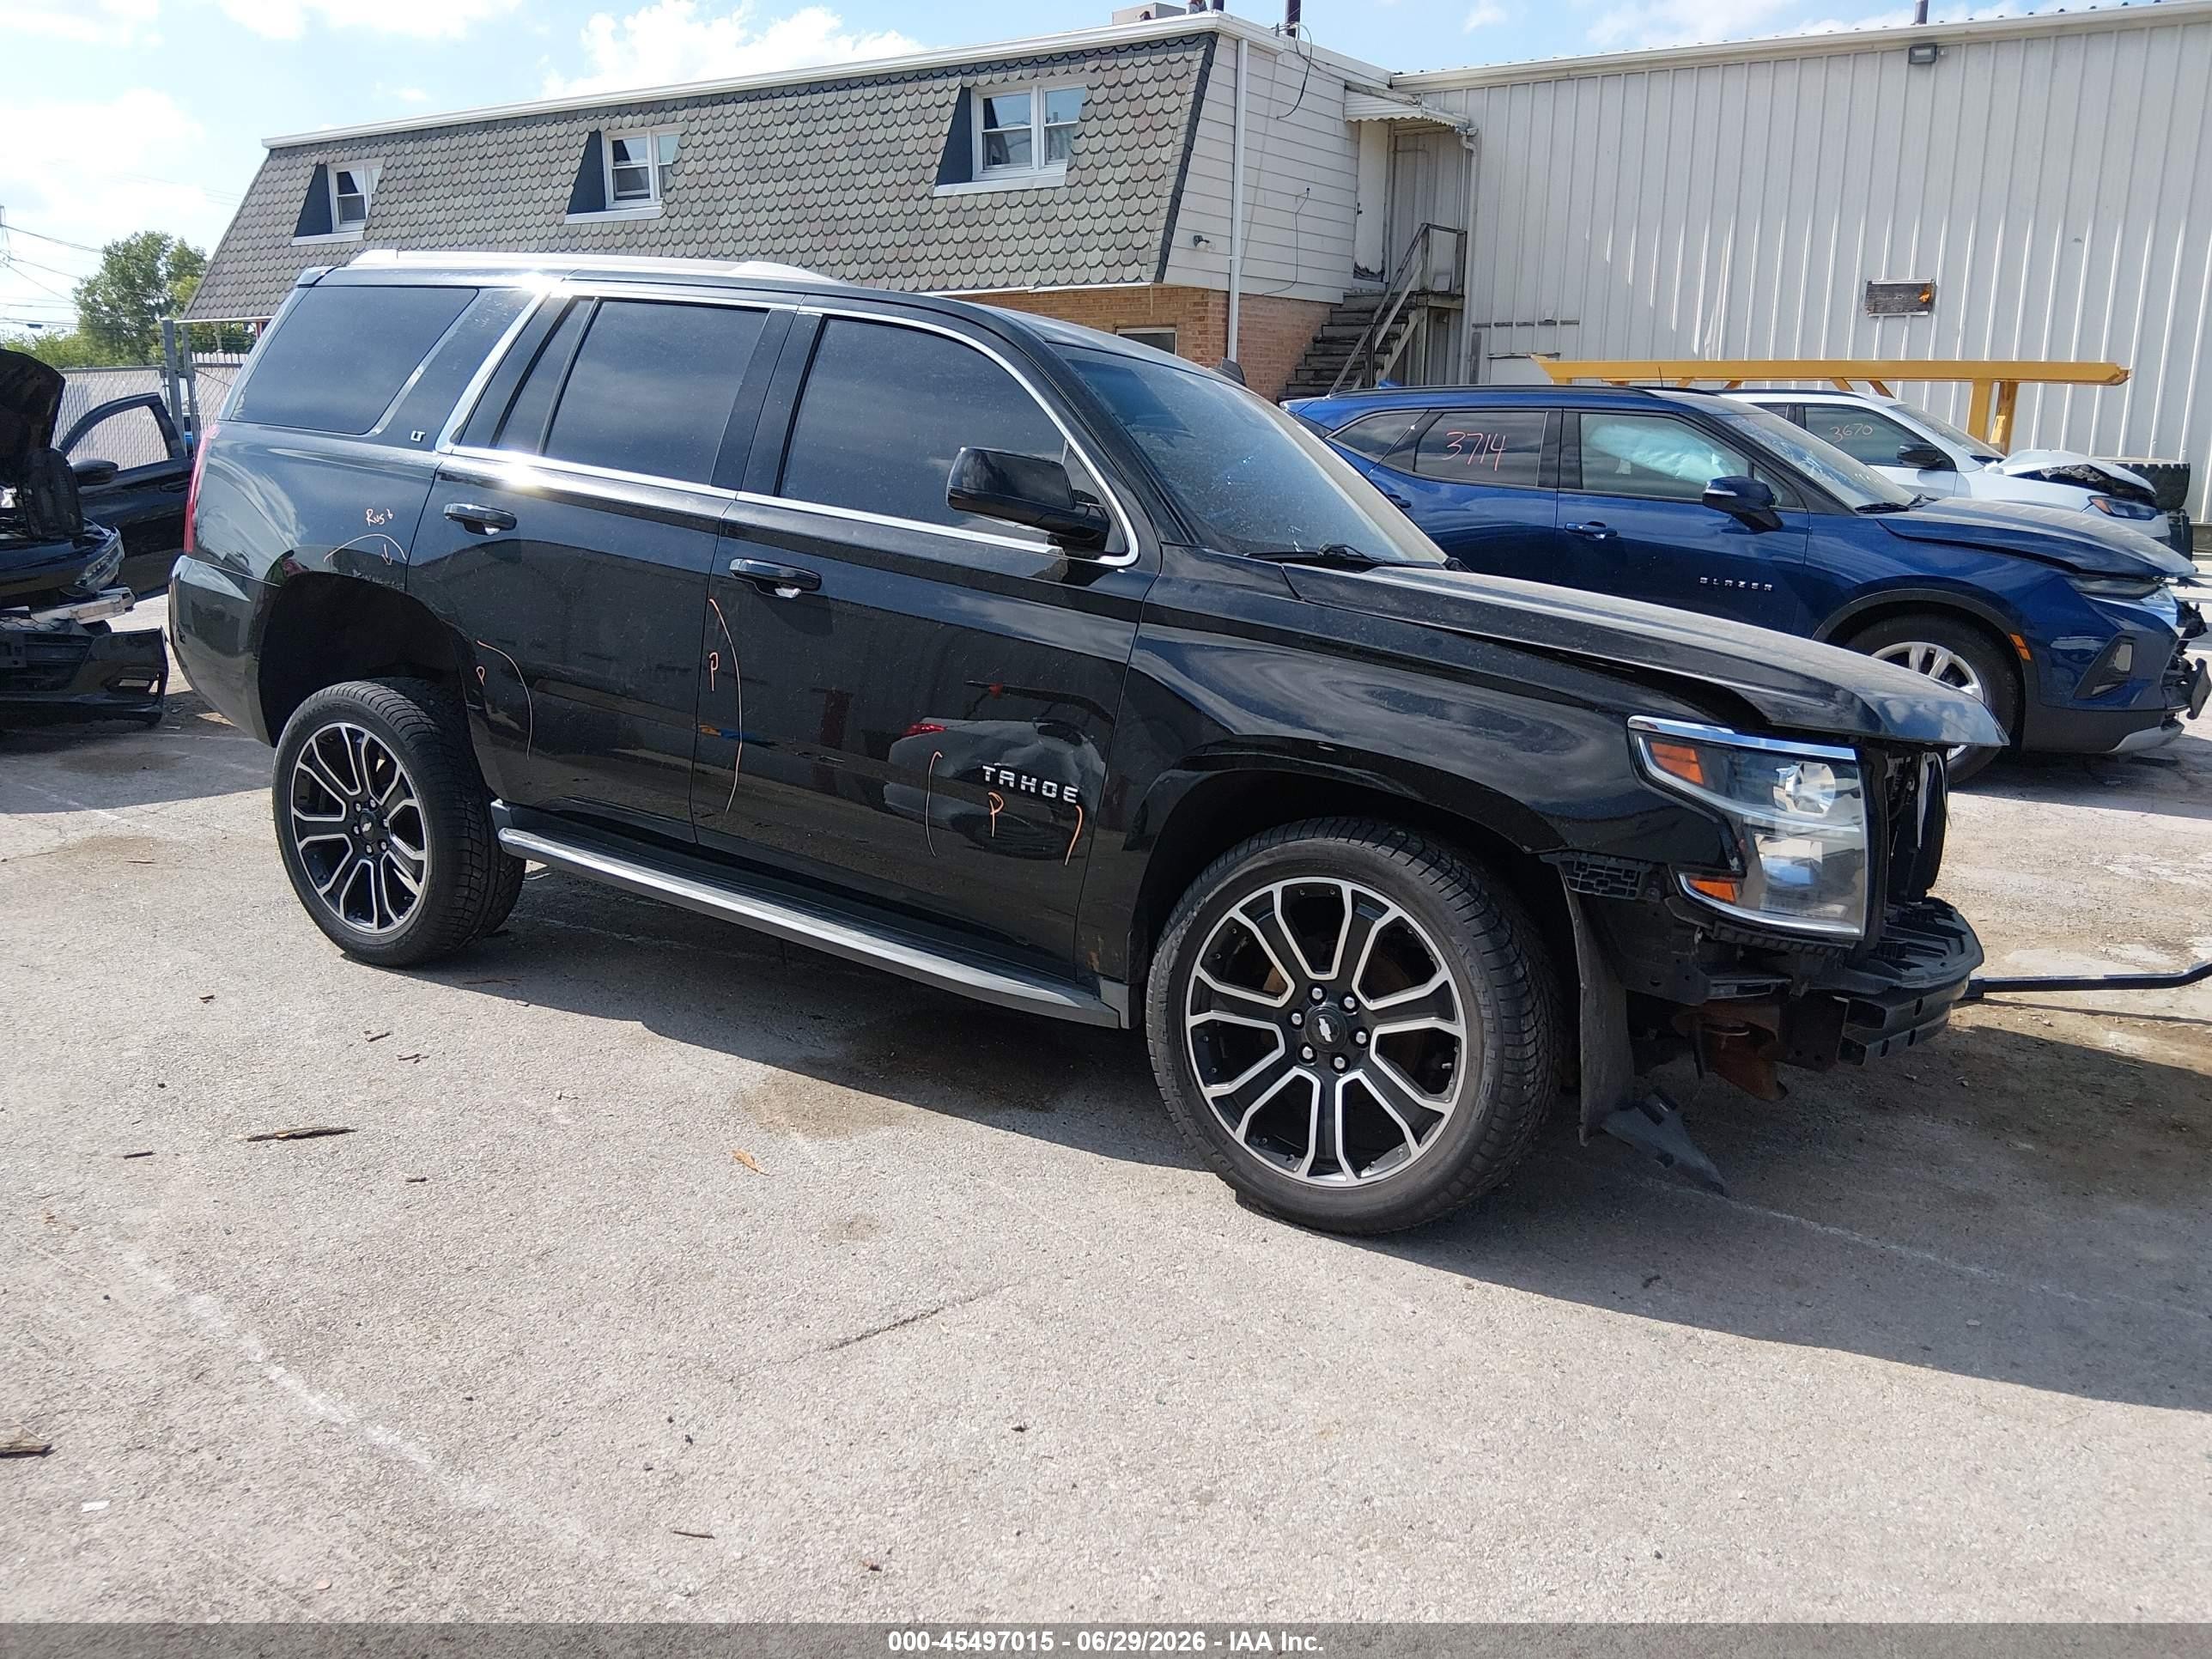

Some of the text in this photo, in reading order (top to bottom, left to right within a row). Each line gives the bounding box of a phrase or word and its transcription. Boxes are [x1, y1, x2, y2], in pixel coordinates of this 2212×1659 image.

[410, 430, 425, 442] LT
[1829, 422, 1874, 443] 3670
[1443, 431, 1507, 471] 3714
[1699, 576, 1773, 591] BLAZER
[982, 764, 1079, 804] TAHOE
